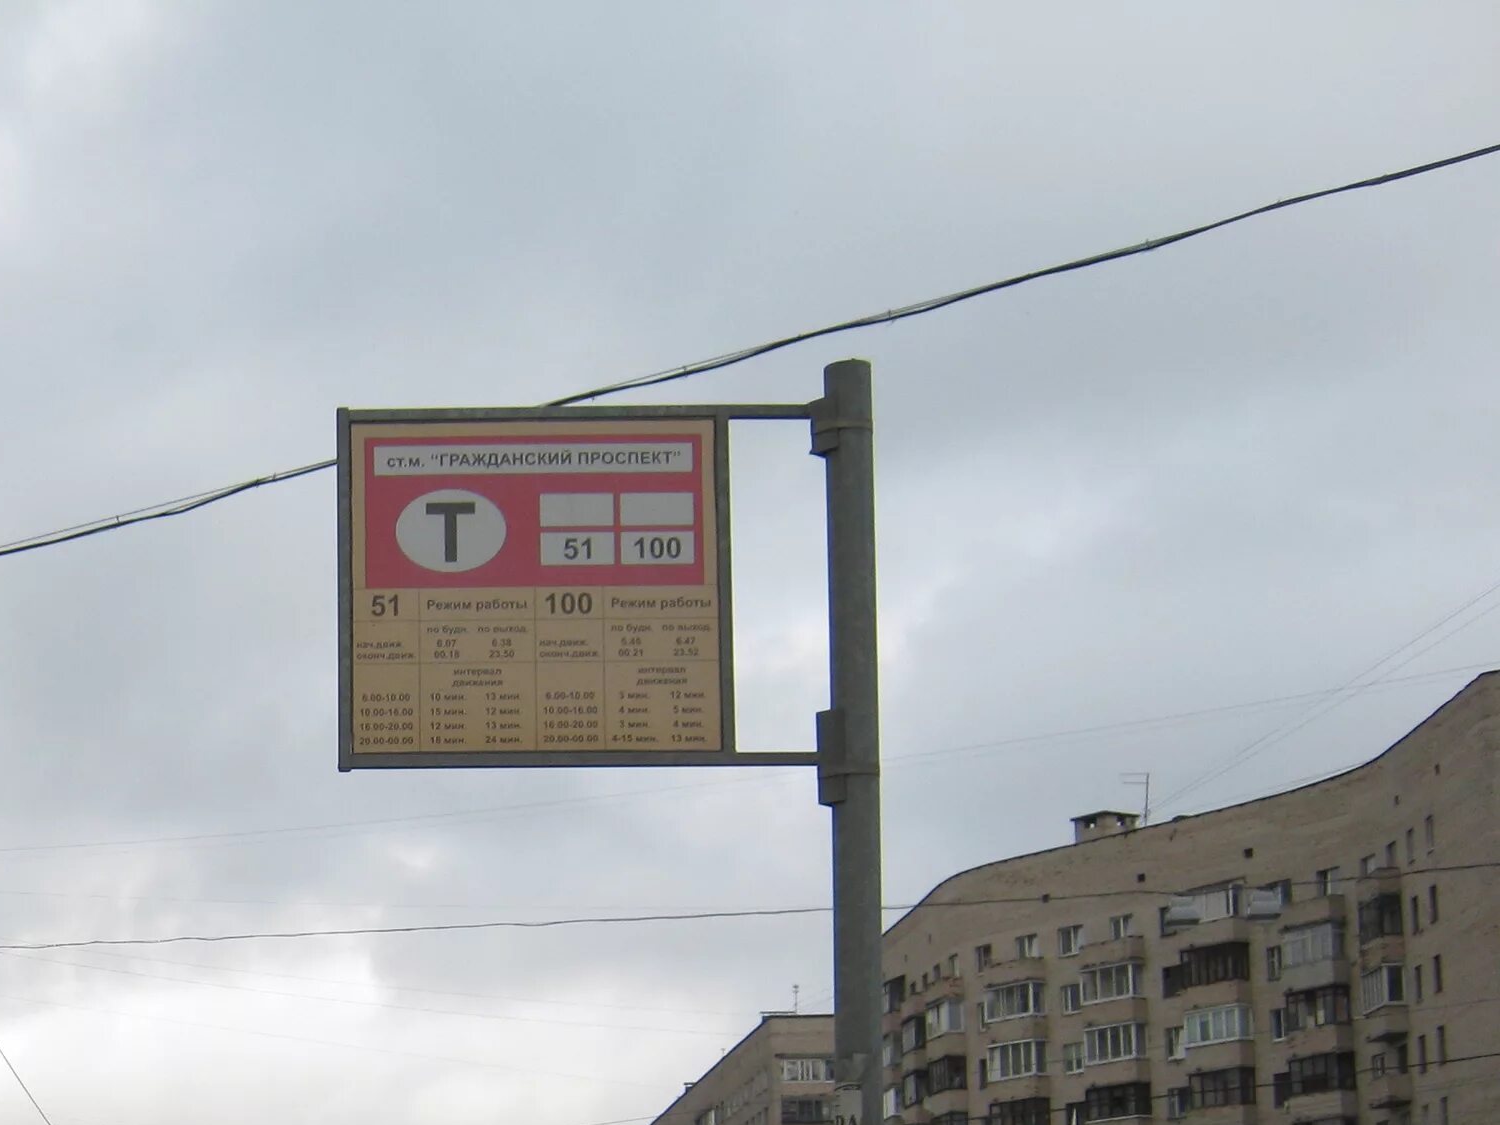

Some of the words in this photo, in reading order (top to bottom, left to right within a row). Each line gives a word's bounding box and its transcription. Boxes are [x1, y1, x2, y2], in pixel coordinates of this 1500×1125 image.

[387, 457, 425, 468] ст.м.
[426, 502, 476, 563] Т
[563, 537, 592, 560] 51
[634, 536, 682, 559] 100
[371, 594, 399, 617] 51
[427, 599, 471, 610] Режим
[476, 598, 528, 613] работы
[545, 592, 592, 615] 100
[611, 597, 656, 609] Режим
[660, 596, 711, 610] работы
[478, 625, 490, 633] по
